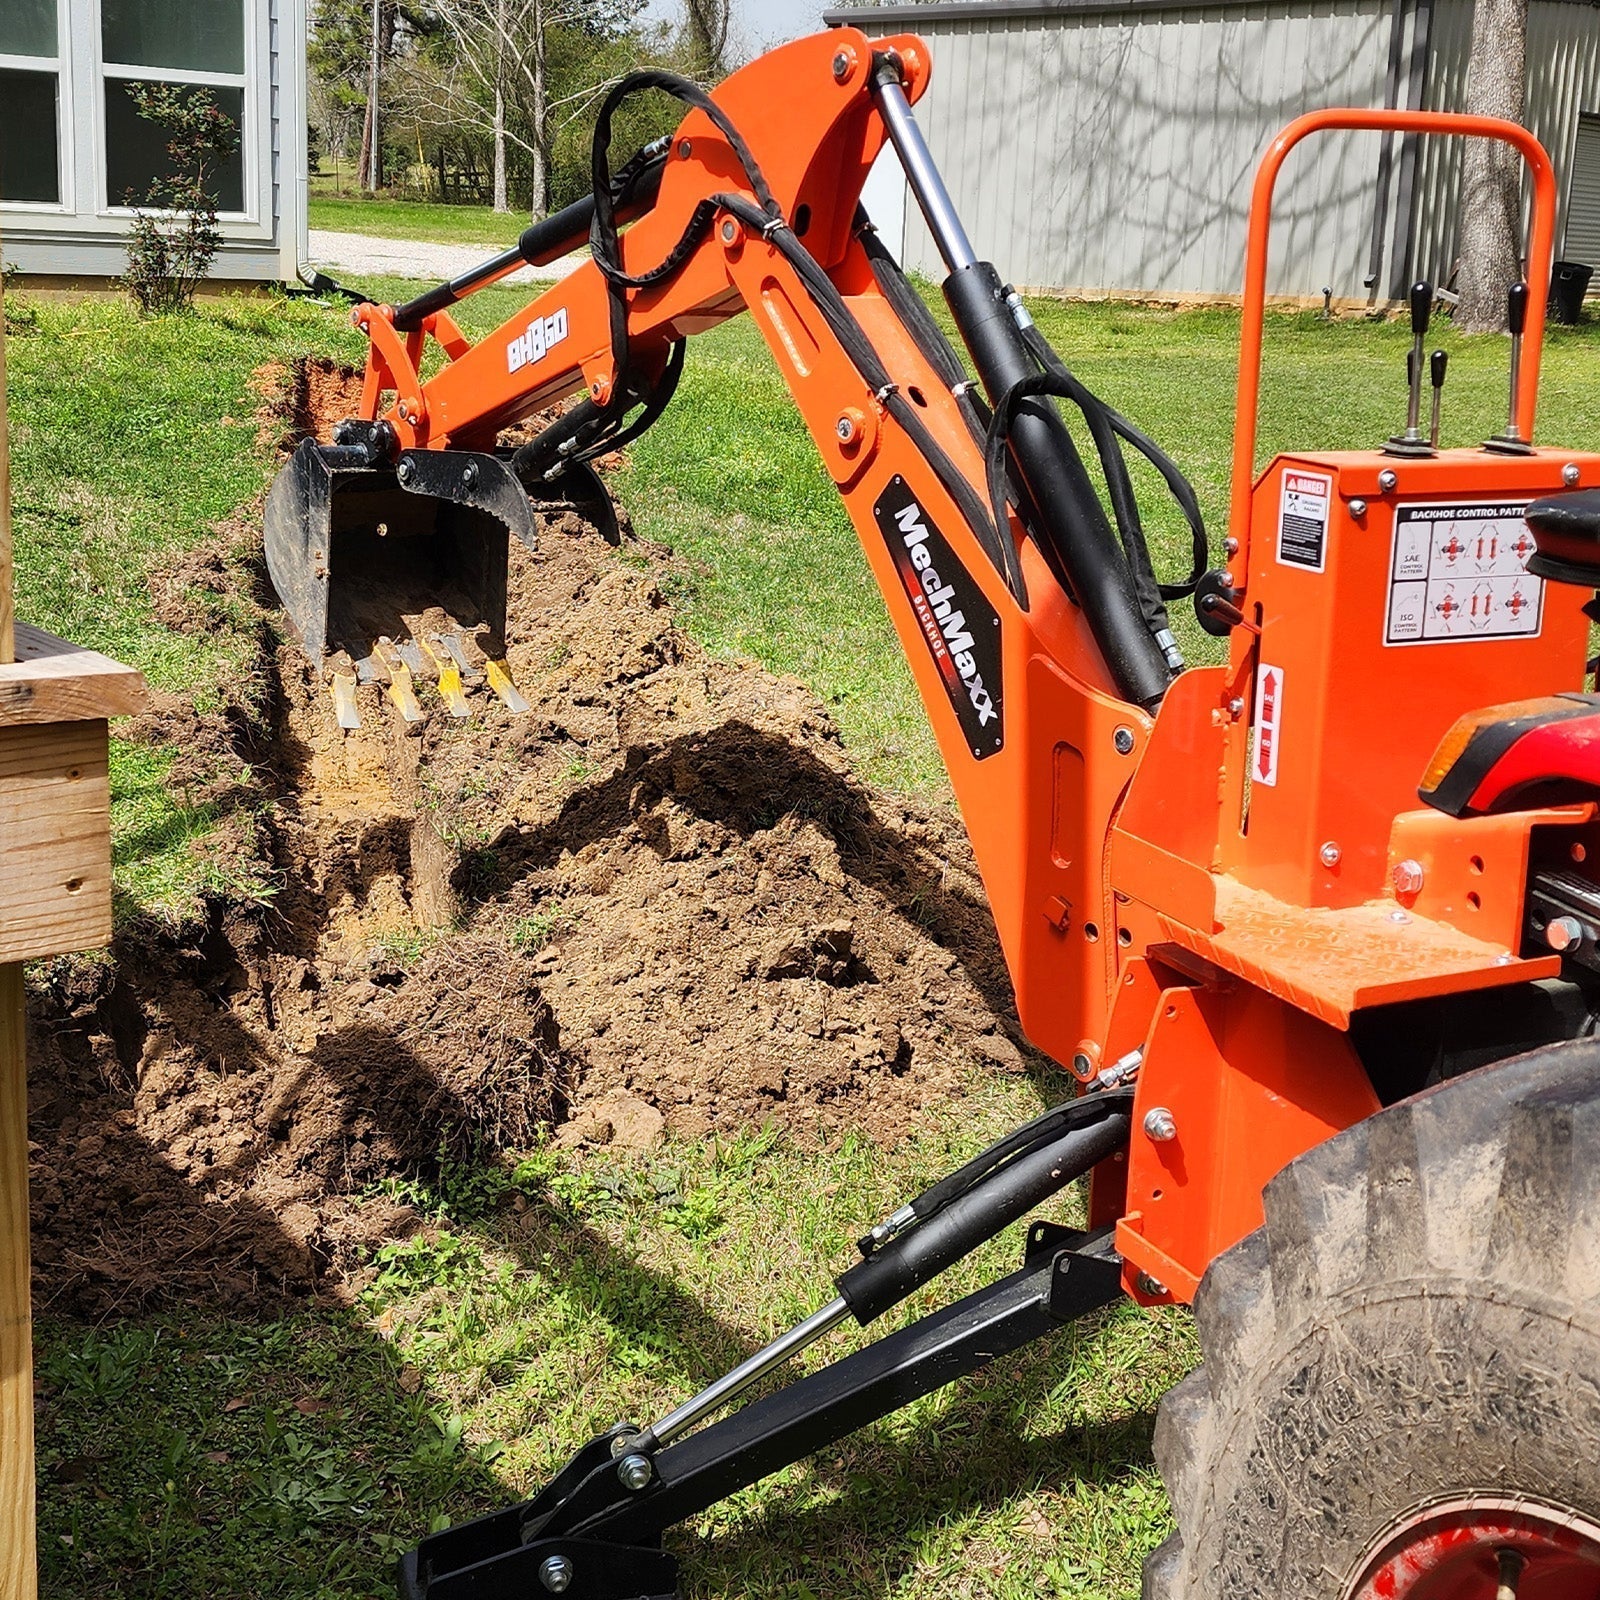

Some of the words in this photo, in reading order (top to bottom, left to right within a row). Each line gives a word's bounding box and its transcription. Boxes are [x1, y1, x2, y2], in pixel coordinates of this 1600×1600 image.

[507, 306, 568, 374] BH860
[1297, 478, 1325, 495] DANGER
[1411, 510, 1455, 519] BACKHOE
[1456, 508, 1498, 518] CONTROL
[1404, 554, 1421, 563] SAE
[894, 503, 998, 727] MechMaxx
[1400, 613, 1415, 621] ISO
[914, 595, 946, 658] BACKHOE
